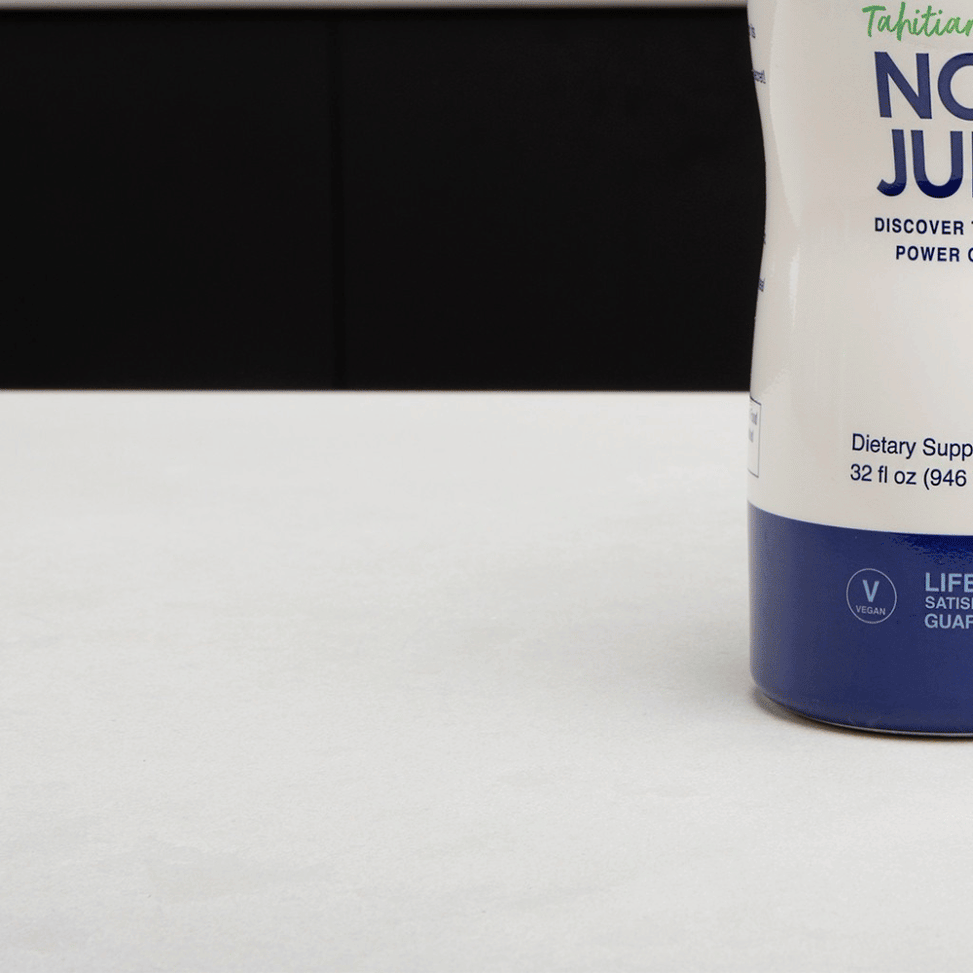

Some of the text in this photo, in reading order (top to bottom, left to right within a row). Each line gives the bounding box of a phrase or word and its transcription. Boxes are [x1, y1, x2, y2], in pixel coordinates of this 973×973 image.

[874, 217, 964, 235] DISCOVER
[895, 245, 960, 262] POWER
[851, 433, 917, 459] Dietary
[850, 463, 872, 482] 32
[878, 465, 888, 483] fl
[893, 469, 917, 485] oz
[923, 468, 967, 491] (946
[862, 579, 880, 603] V
[855, 605, 886, 616] VEGAN
